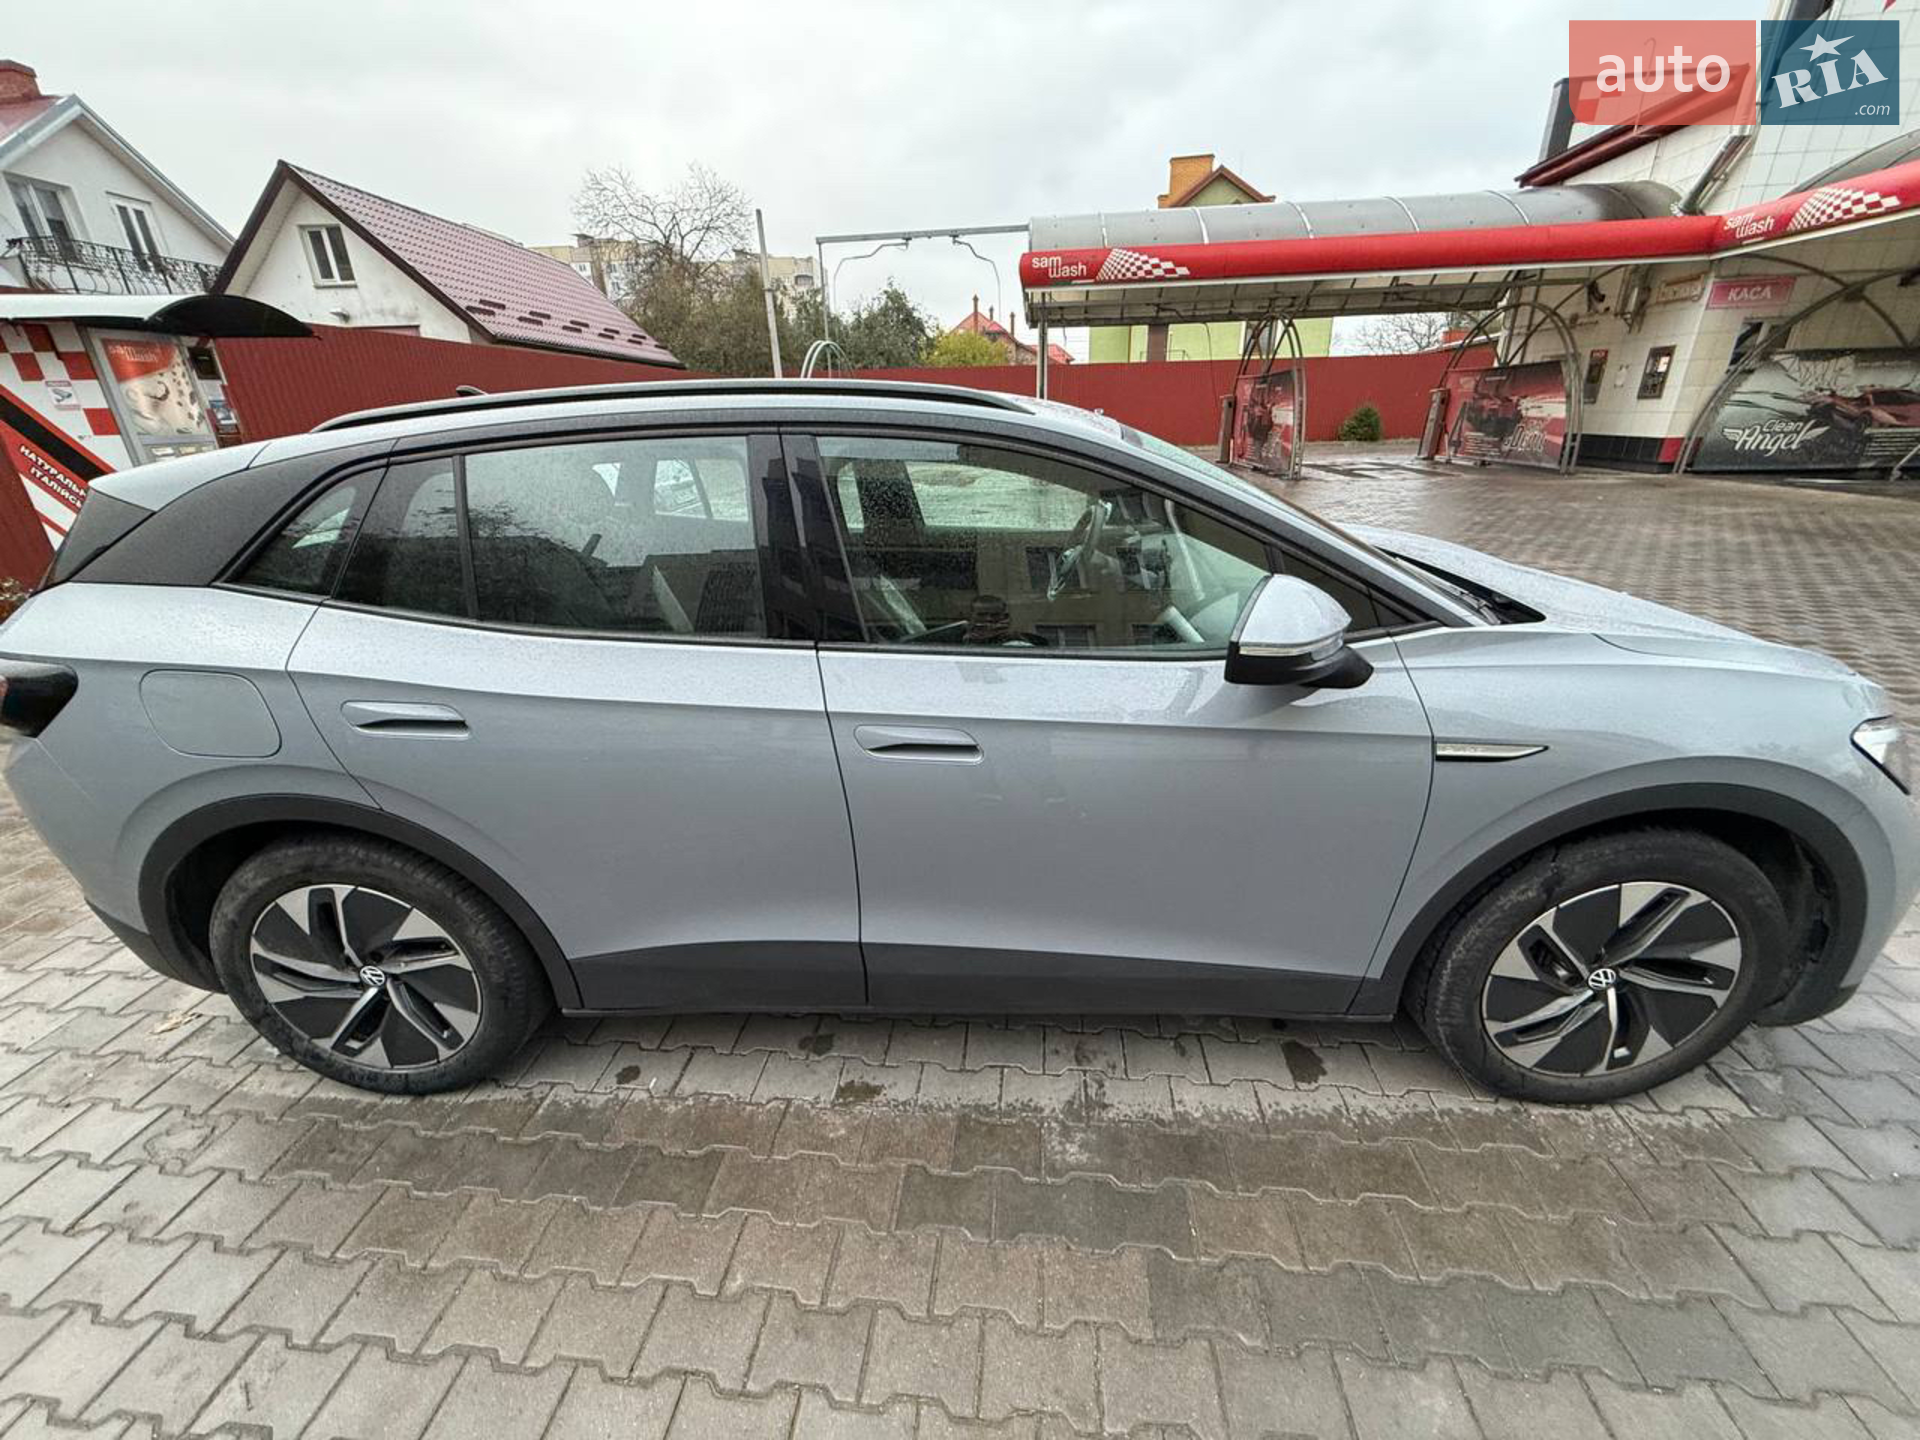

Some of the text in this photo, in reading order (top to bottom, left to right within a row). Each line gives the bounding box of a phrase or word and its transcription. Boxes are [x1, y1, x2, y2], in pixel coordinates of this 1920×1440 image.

[1724, 213, 1753, 230] sam
[1032, 256, 1062, 268] sam
[1728, 286, 1772, 301] КАСА
[1763, 419, 1802, 432] Clean
[1735, 419, 1817, 457] Angel
